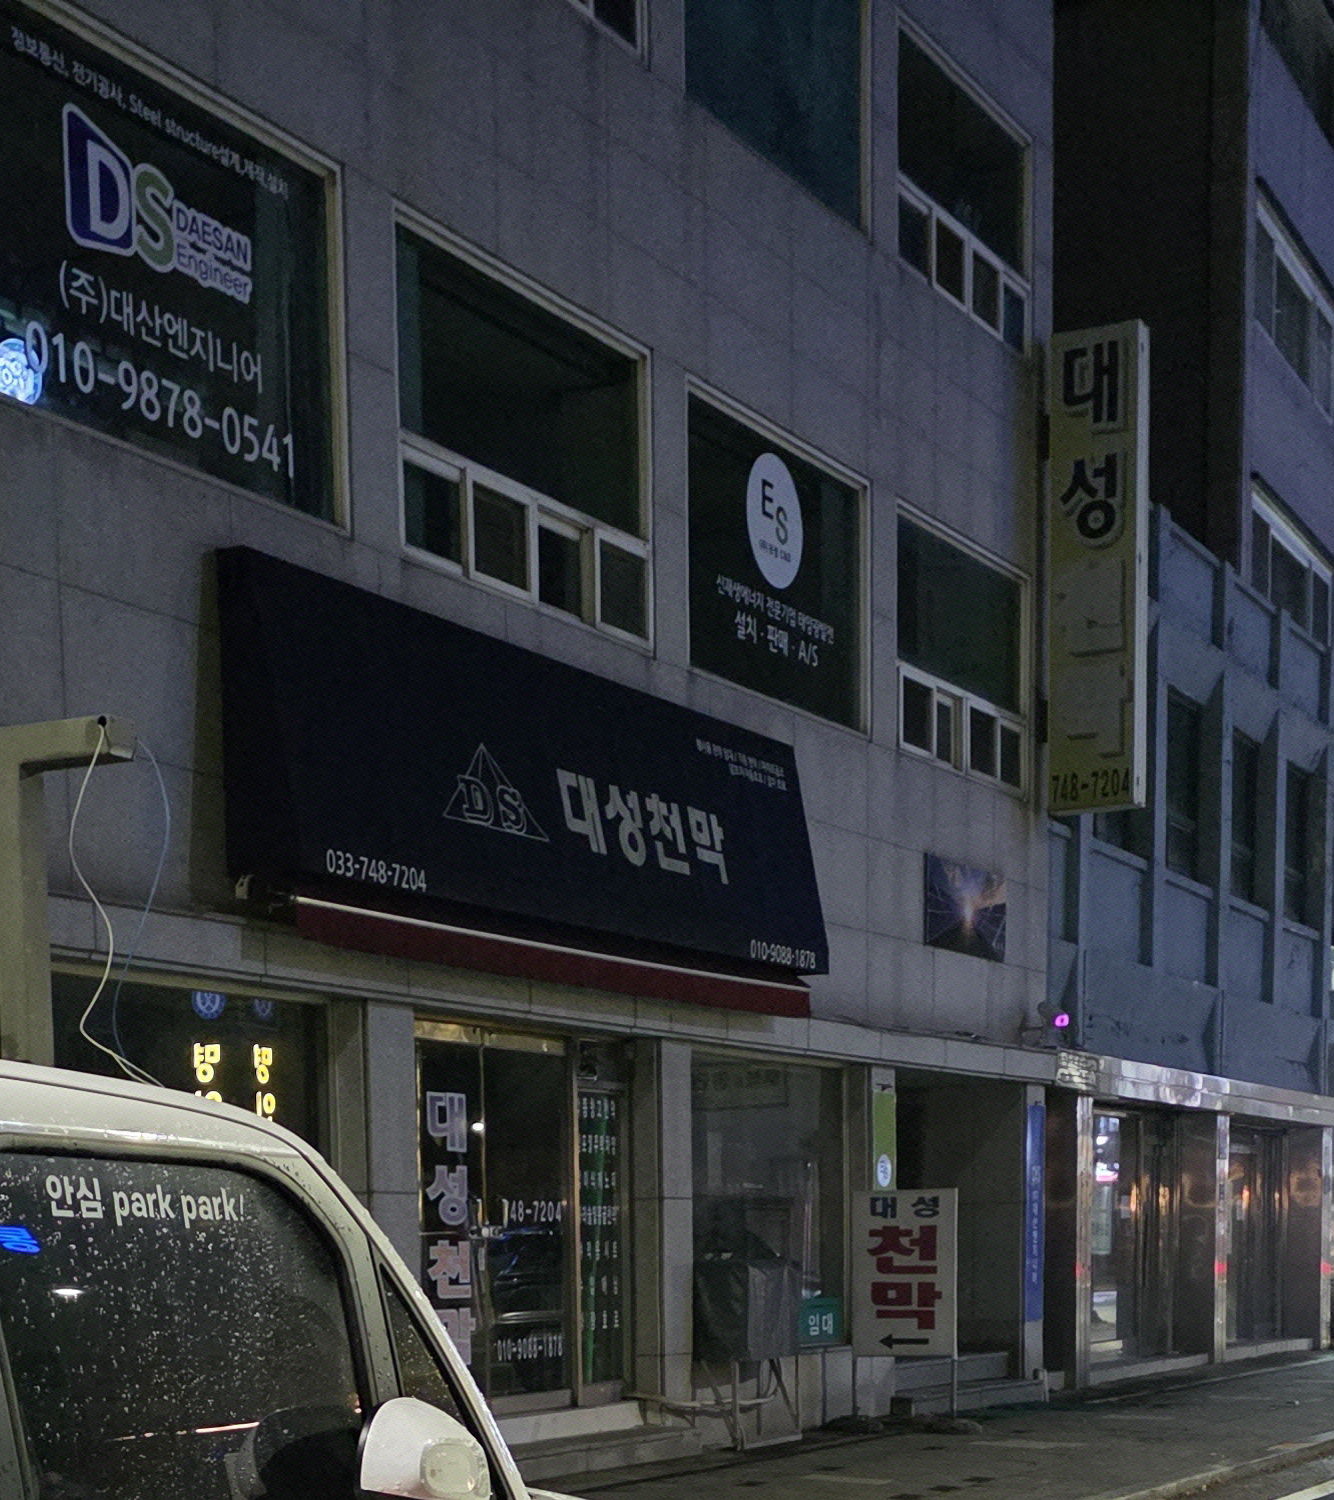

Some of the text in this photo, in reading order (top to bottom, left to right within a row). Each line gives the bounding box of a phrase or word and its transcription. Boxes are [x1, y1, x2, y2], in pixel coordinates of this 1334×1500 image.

[83, 136, 176, 273] DS
[175, 205, 251, 266] DAESAN
[175, 241, 251, 299] Engineer
[60, 260, 264, 394] (주)대산엔지니어
[26, 321, 295, 479] 010-9878-0541
[1060, 340, 1120, 541] 대성
[761, 478, 789, 546] ES
[735, 610, 758, 645] 설치
[798, 640, 819, 667] A/S
[456, 774, 528, 836] DS
[556, 768, 730, 886] 대성천막
[325, 847, 428, 894] 033-748-7204
[750, 938, 817, 971] 010-9088-1878
[45, 1174, 245, 1229] 안심 park park!
[504, 1199, 563, 1224] 48-7204
[869, 1196, 941, 1220] 대성
[867, 1224, 943, 1330] 천막
[808, 1312, 833, 1337] 임대
